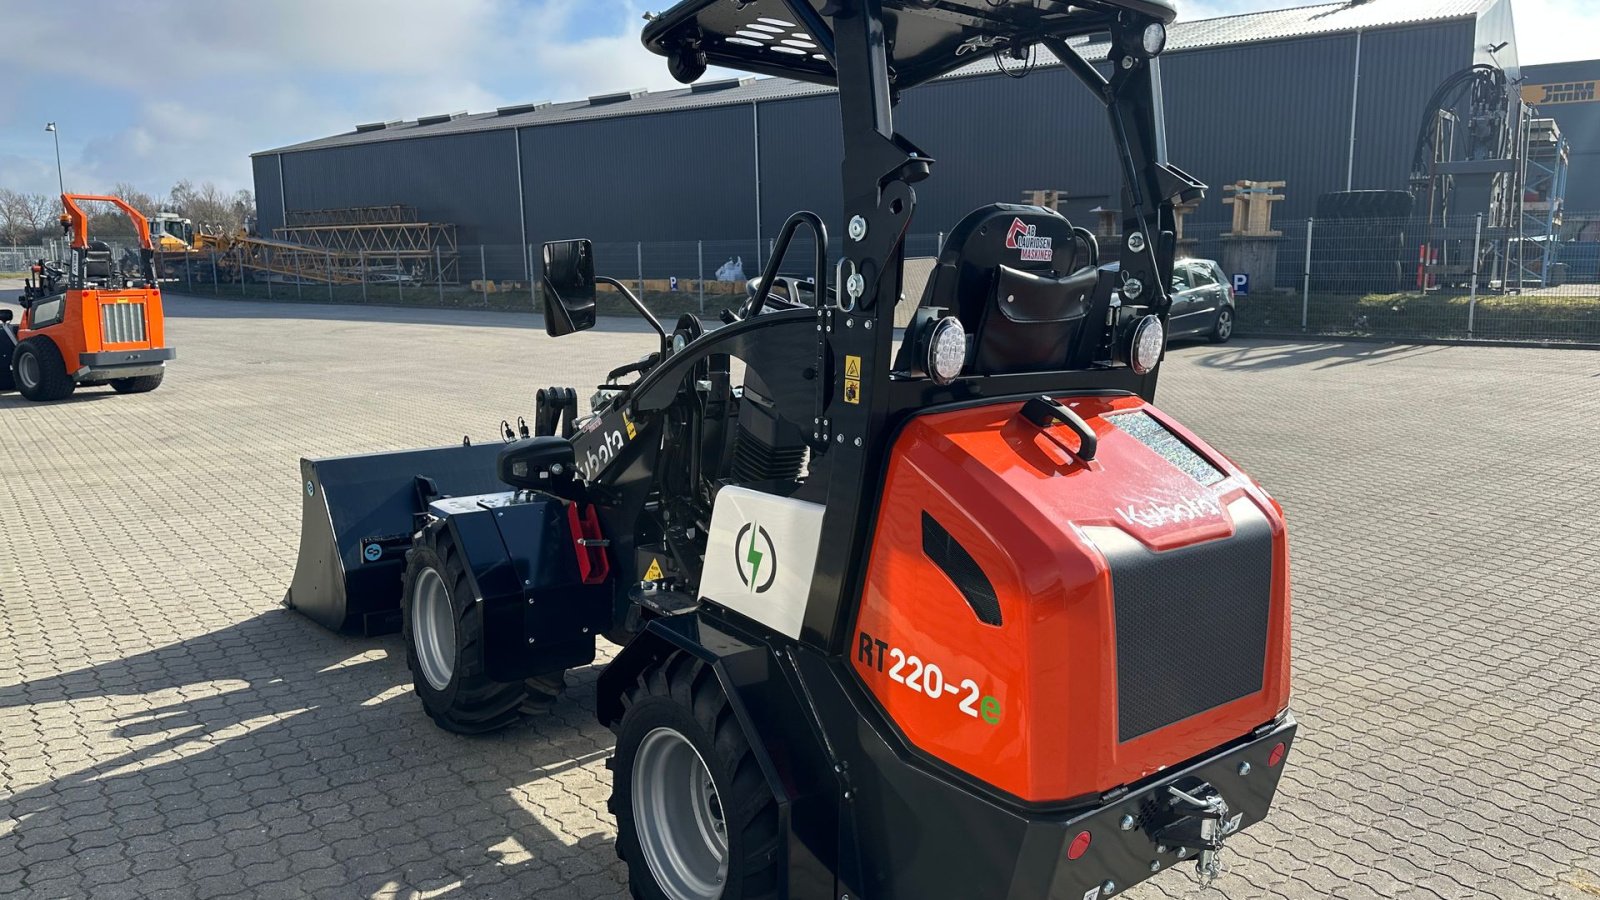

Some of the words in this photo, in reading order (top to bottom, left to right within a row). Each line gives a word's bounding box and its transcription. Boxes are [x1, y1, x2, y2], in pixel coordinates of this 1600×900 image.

[1541, 82, 1595, 103] JMM
[1027, 225, 1036, 236] AB
[1021, 249, 1052, 260] MASKINER
[670, 276, 677, 288] P
[1234, 274, 1247, 290] P
[1114, 495, 1221, 529] Kubota
